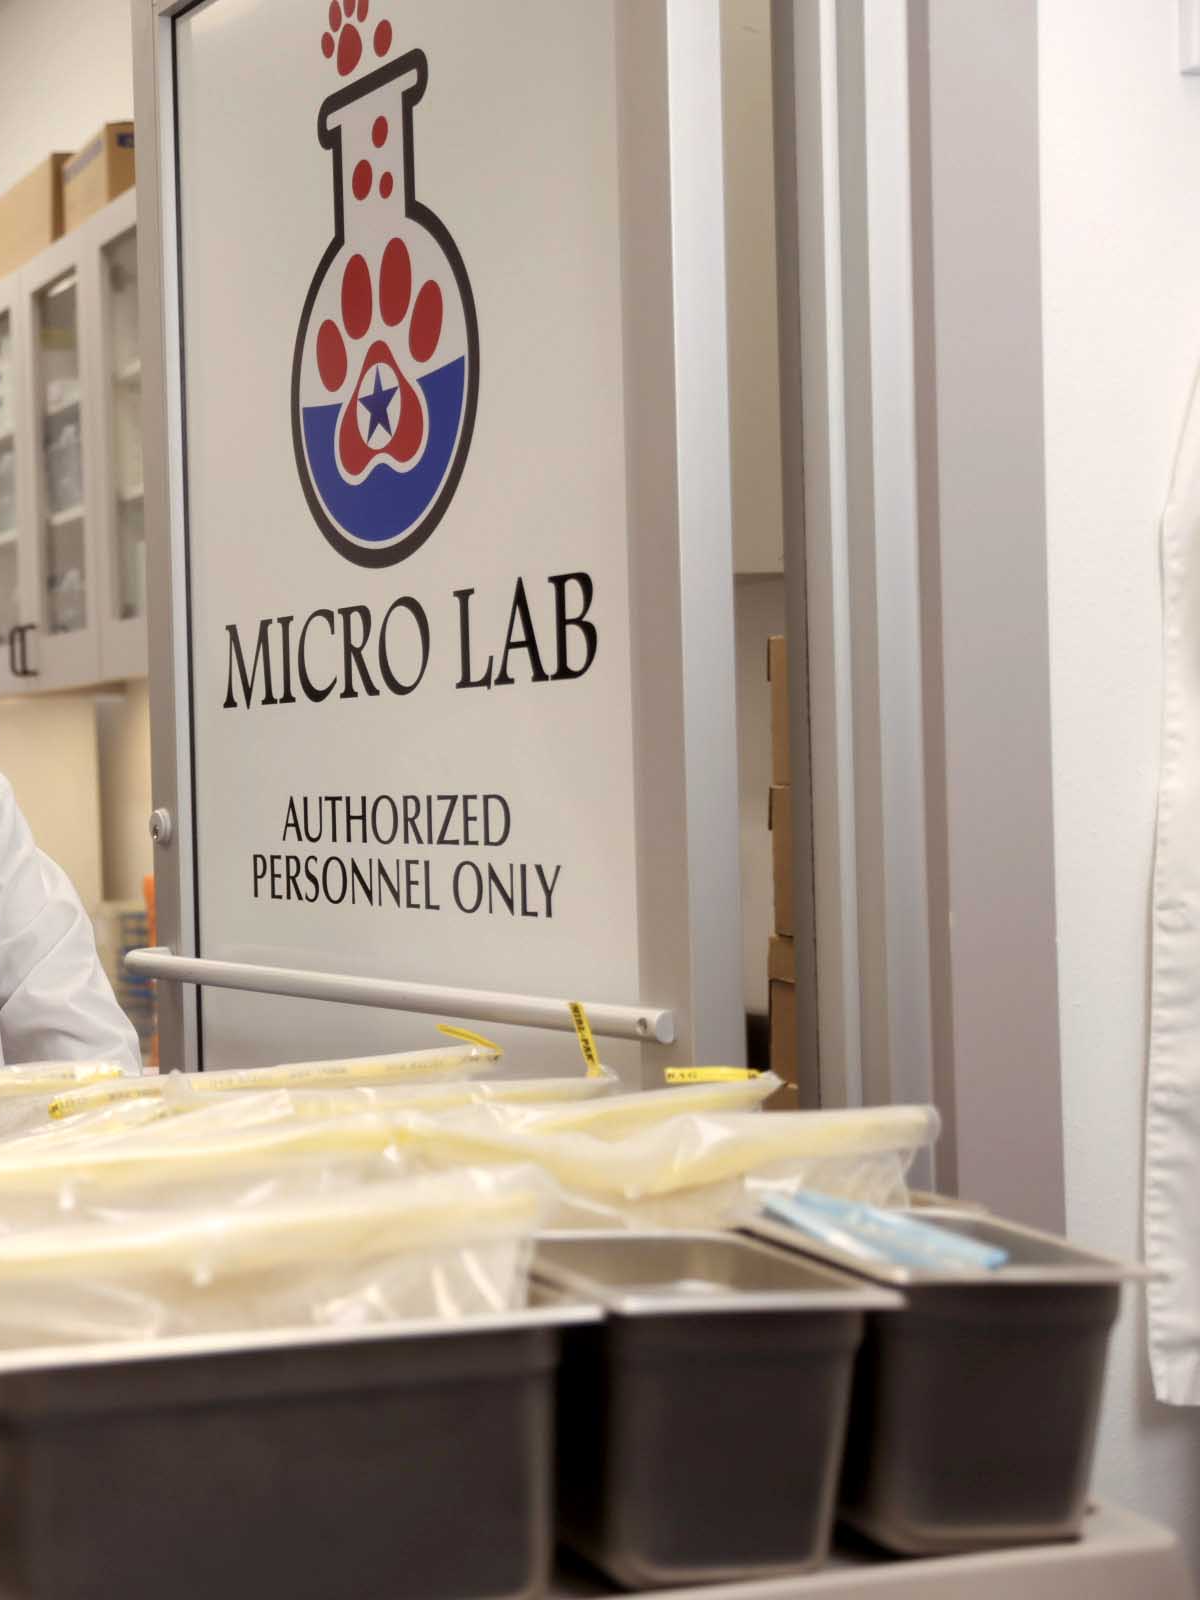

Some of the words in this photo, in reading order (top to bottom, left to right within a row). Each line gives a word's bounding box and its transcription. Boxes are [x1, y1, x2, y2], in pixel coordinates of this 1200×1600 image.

[223, 595, 430, 710] MICRO
[453, 571, 598, 690] LAB
[282, 794, 511, 847] AUTHORIZED
[252, 854, 440, 911] PERSONNEL
[453, 860, 562, 918] ONLY
